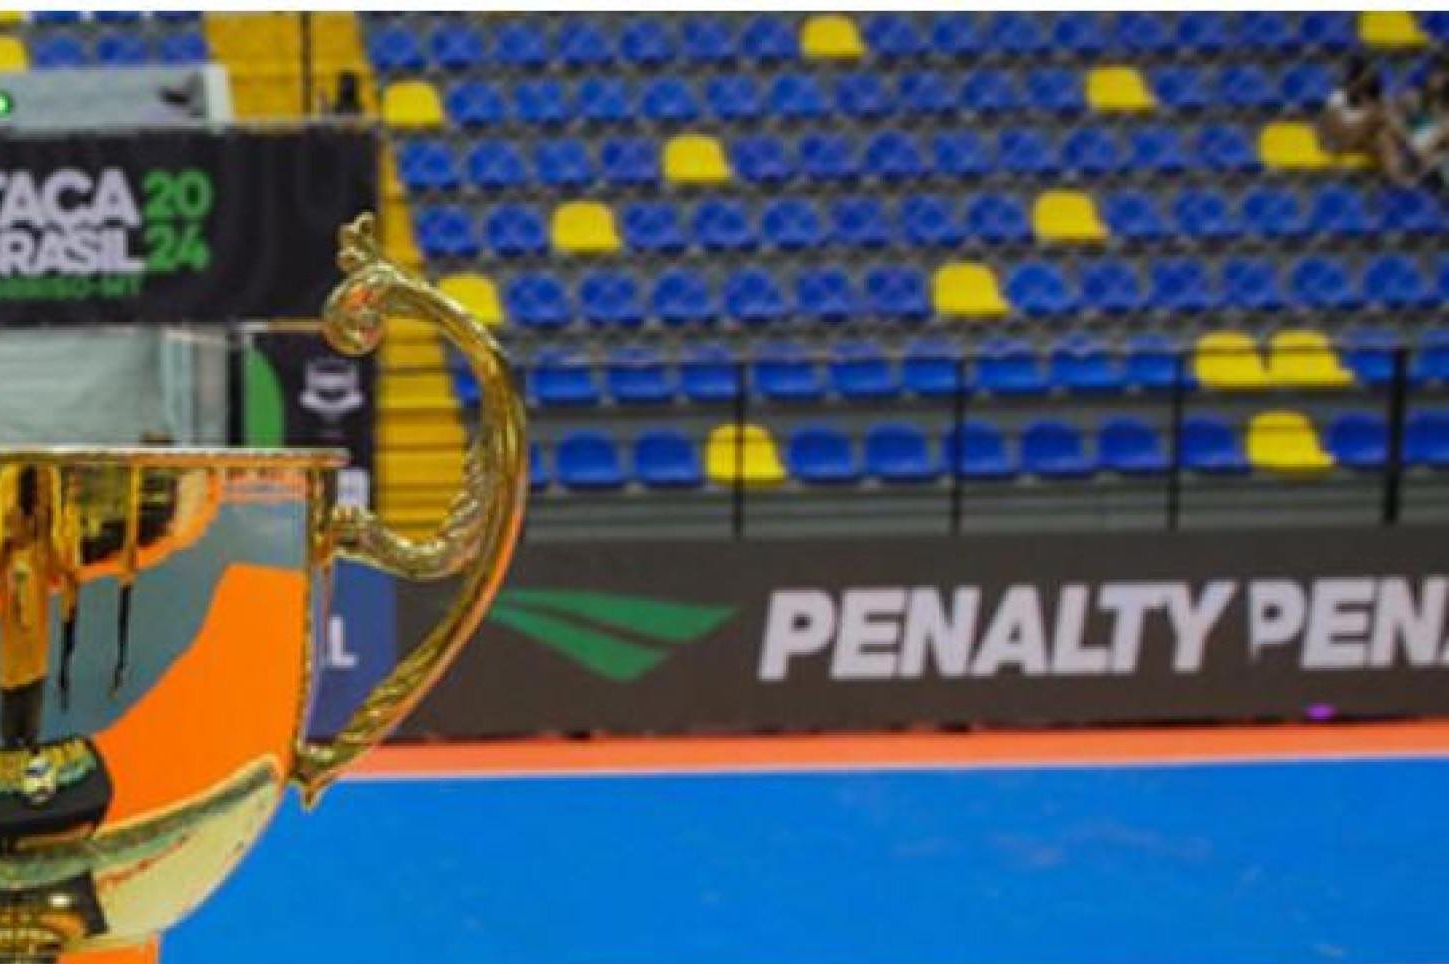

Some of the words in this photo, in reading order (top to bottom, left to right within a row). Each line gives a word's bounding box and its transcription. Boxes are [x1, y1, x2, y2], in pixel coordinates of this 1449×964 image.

[142, 169, 214, 218] 20
[143, 222, 211, 272] 24
[757, 578, 1236, 682] PENALTY
[1248, 575, 1449, 669] PEN
